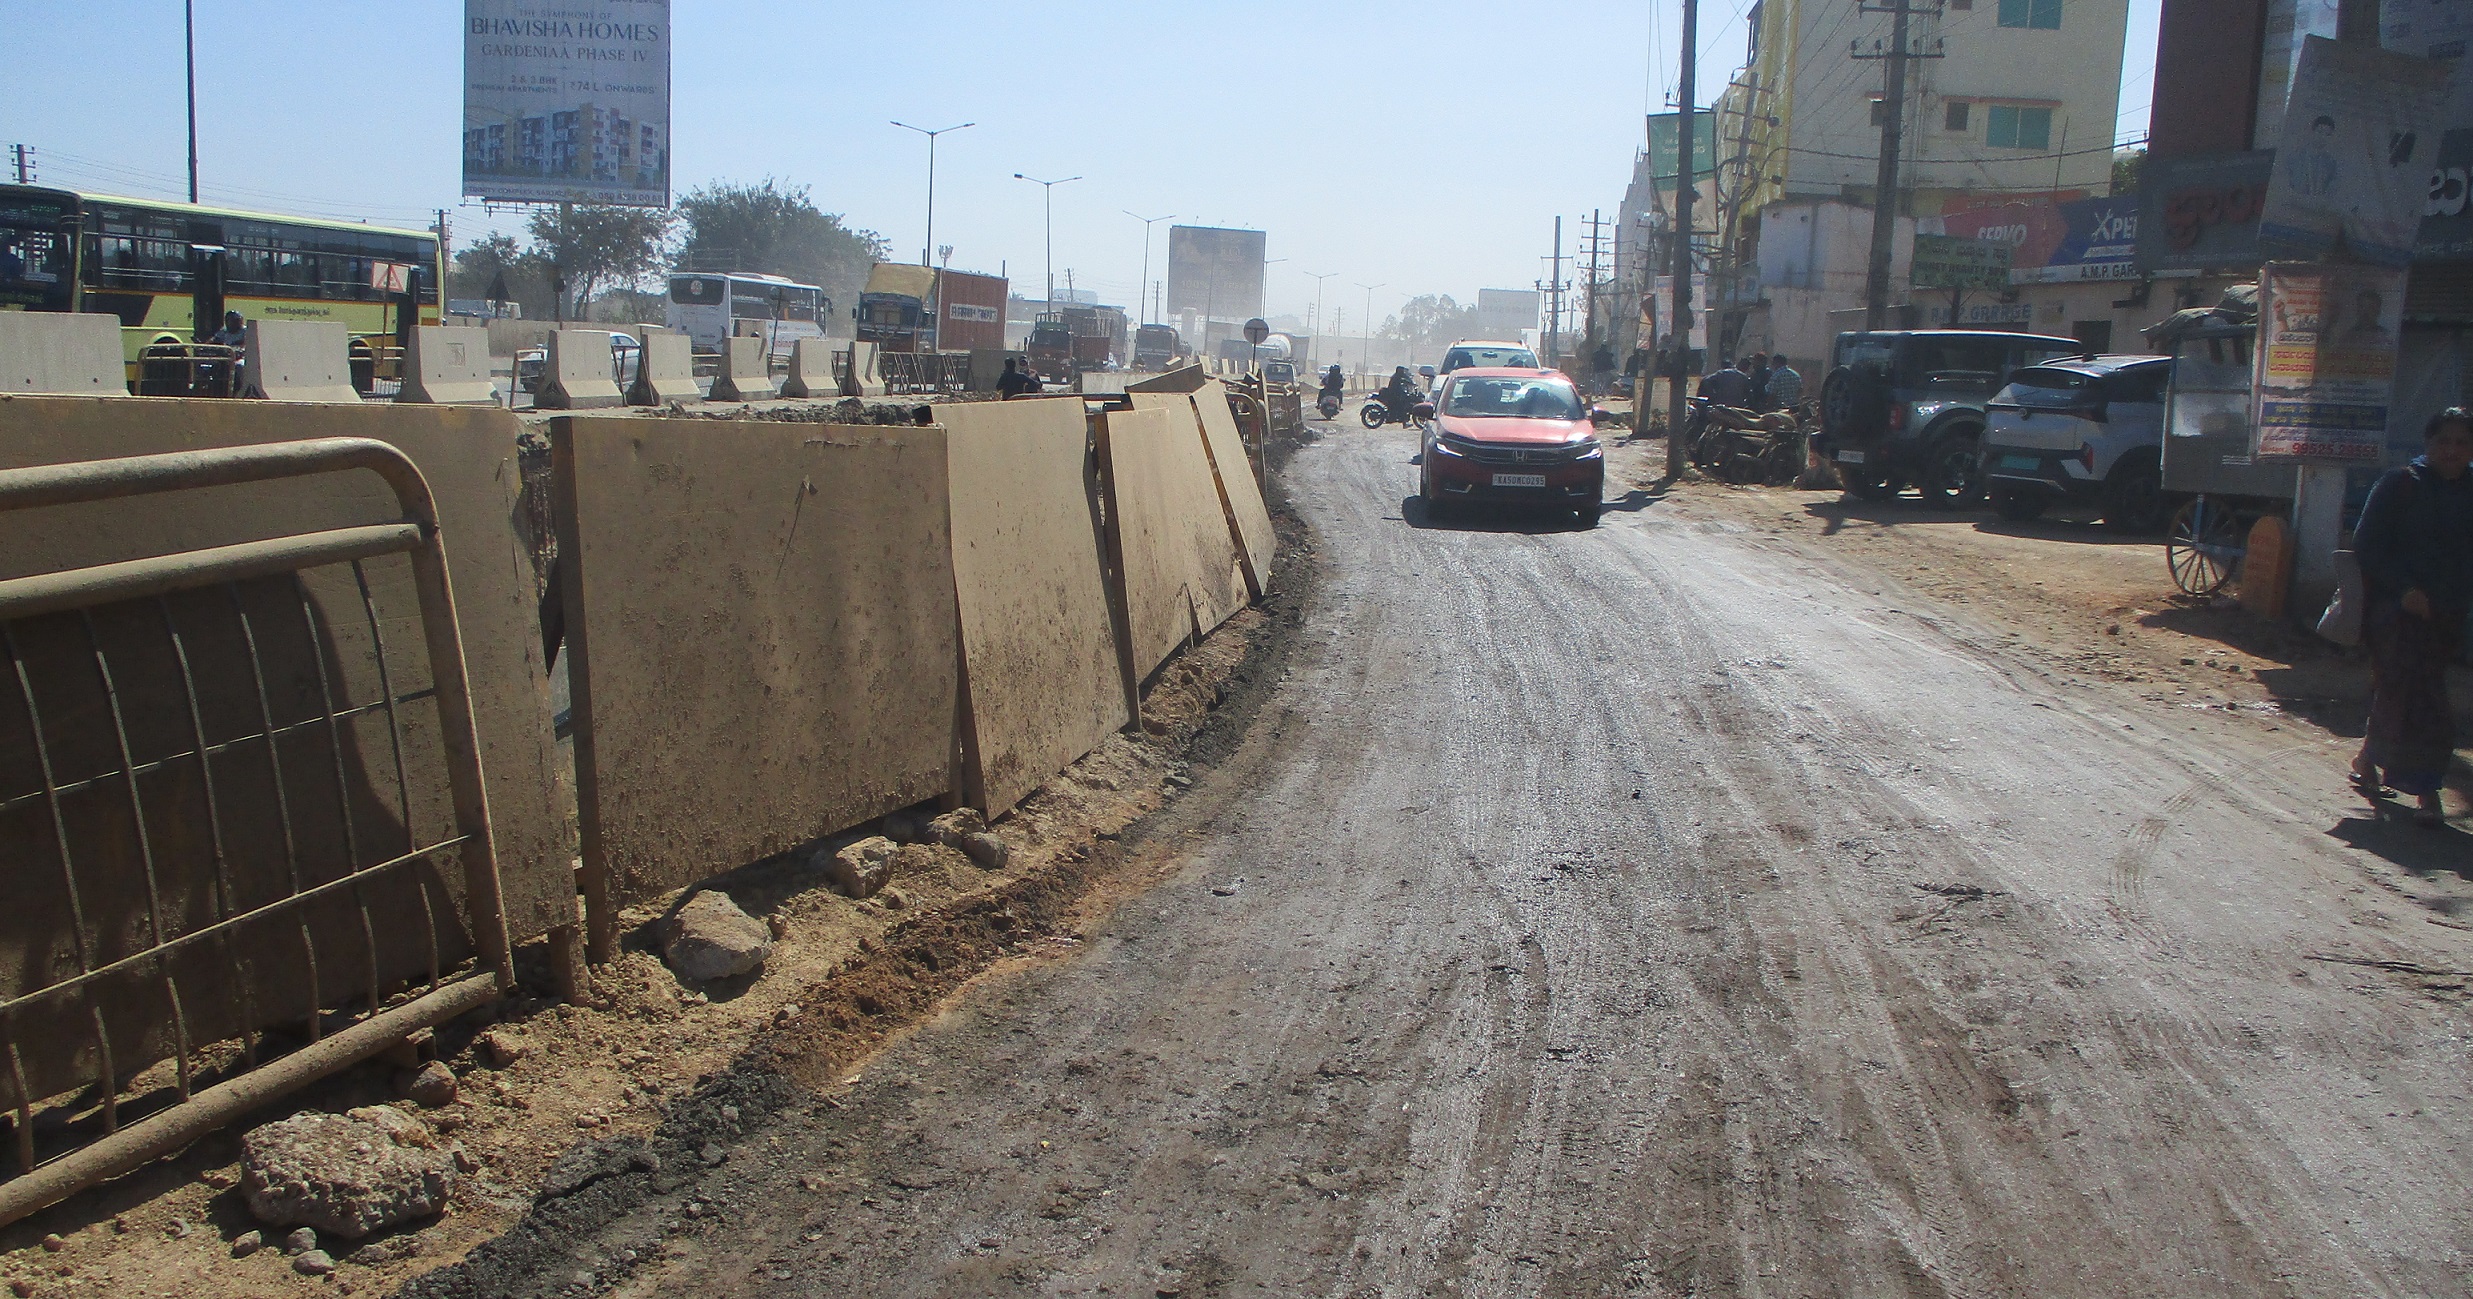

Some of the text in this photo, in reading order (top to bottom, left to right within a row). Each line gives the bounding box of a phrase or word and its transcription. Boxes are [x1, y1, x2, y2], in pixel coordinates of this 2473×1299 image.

[541, 10, 595, 19] SYMPHONY
[471, 17, 659, 42] BHAVISHA HOMES
[481, 43, 648, 62] GARDENIAA PHASE IV
[539, 76, 558, 85] BHK
